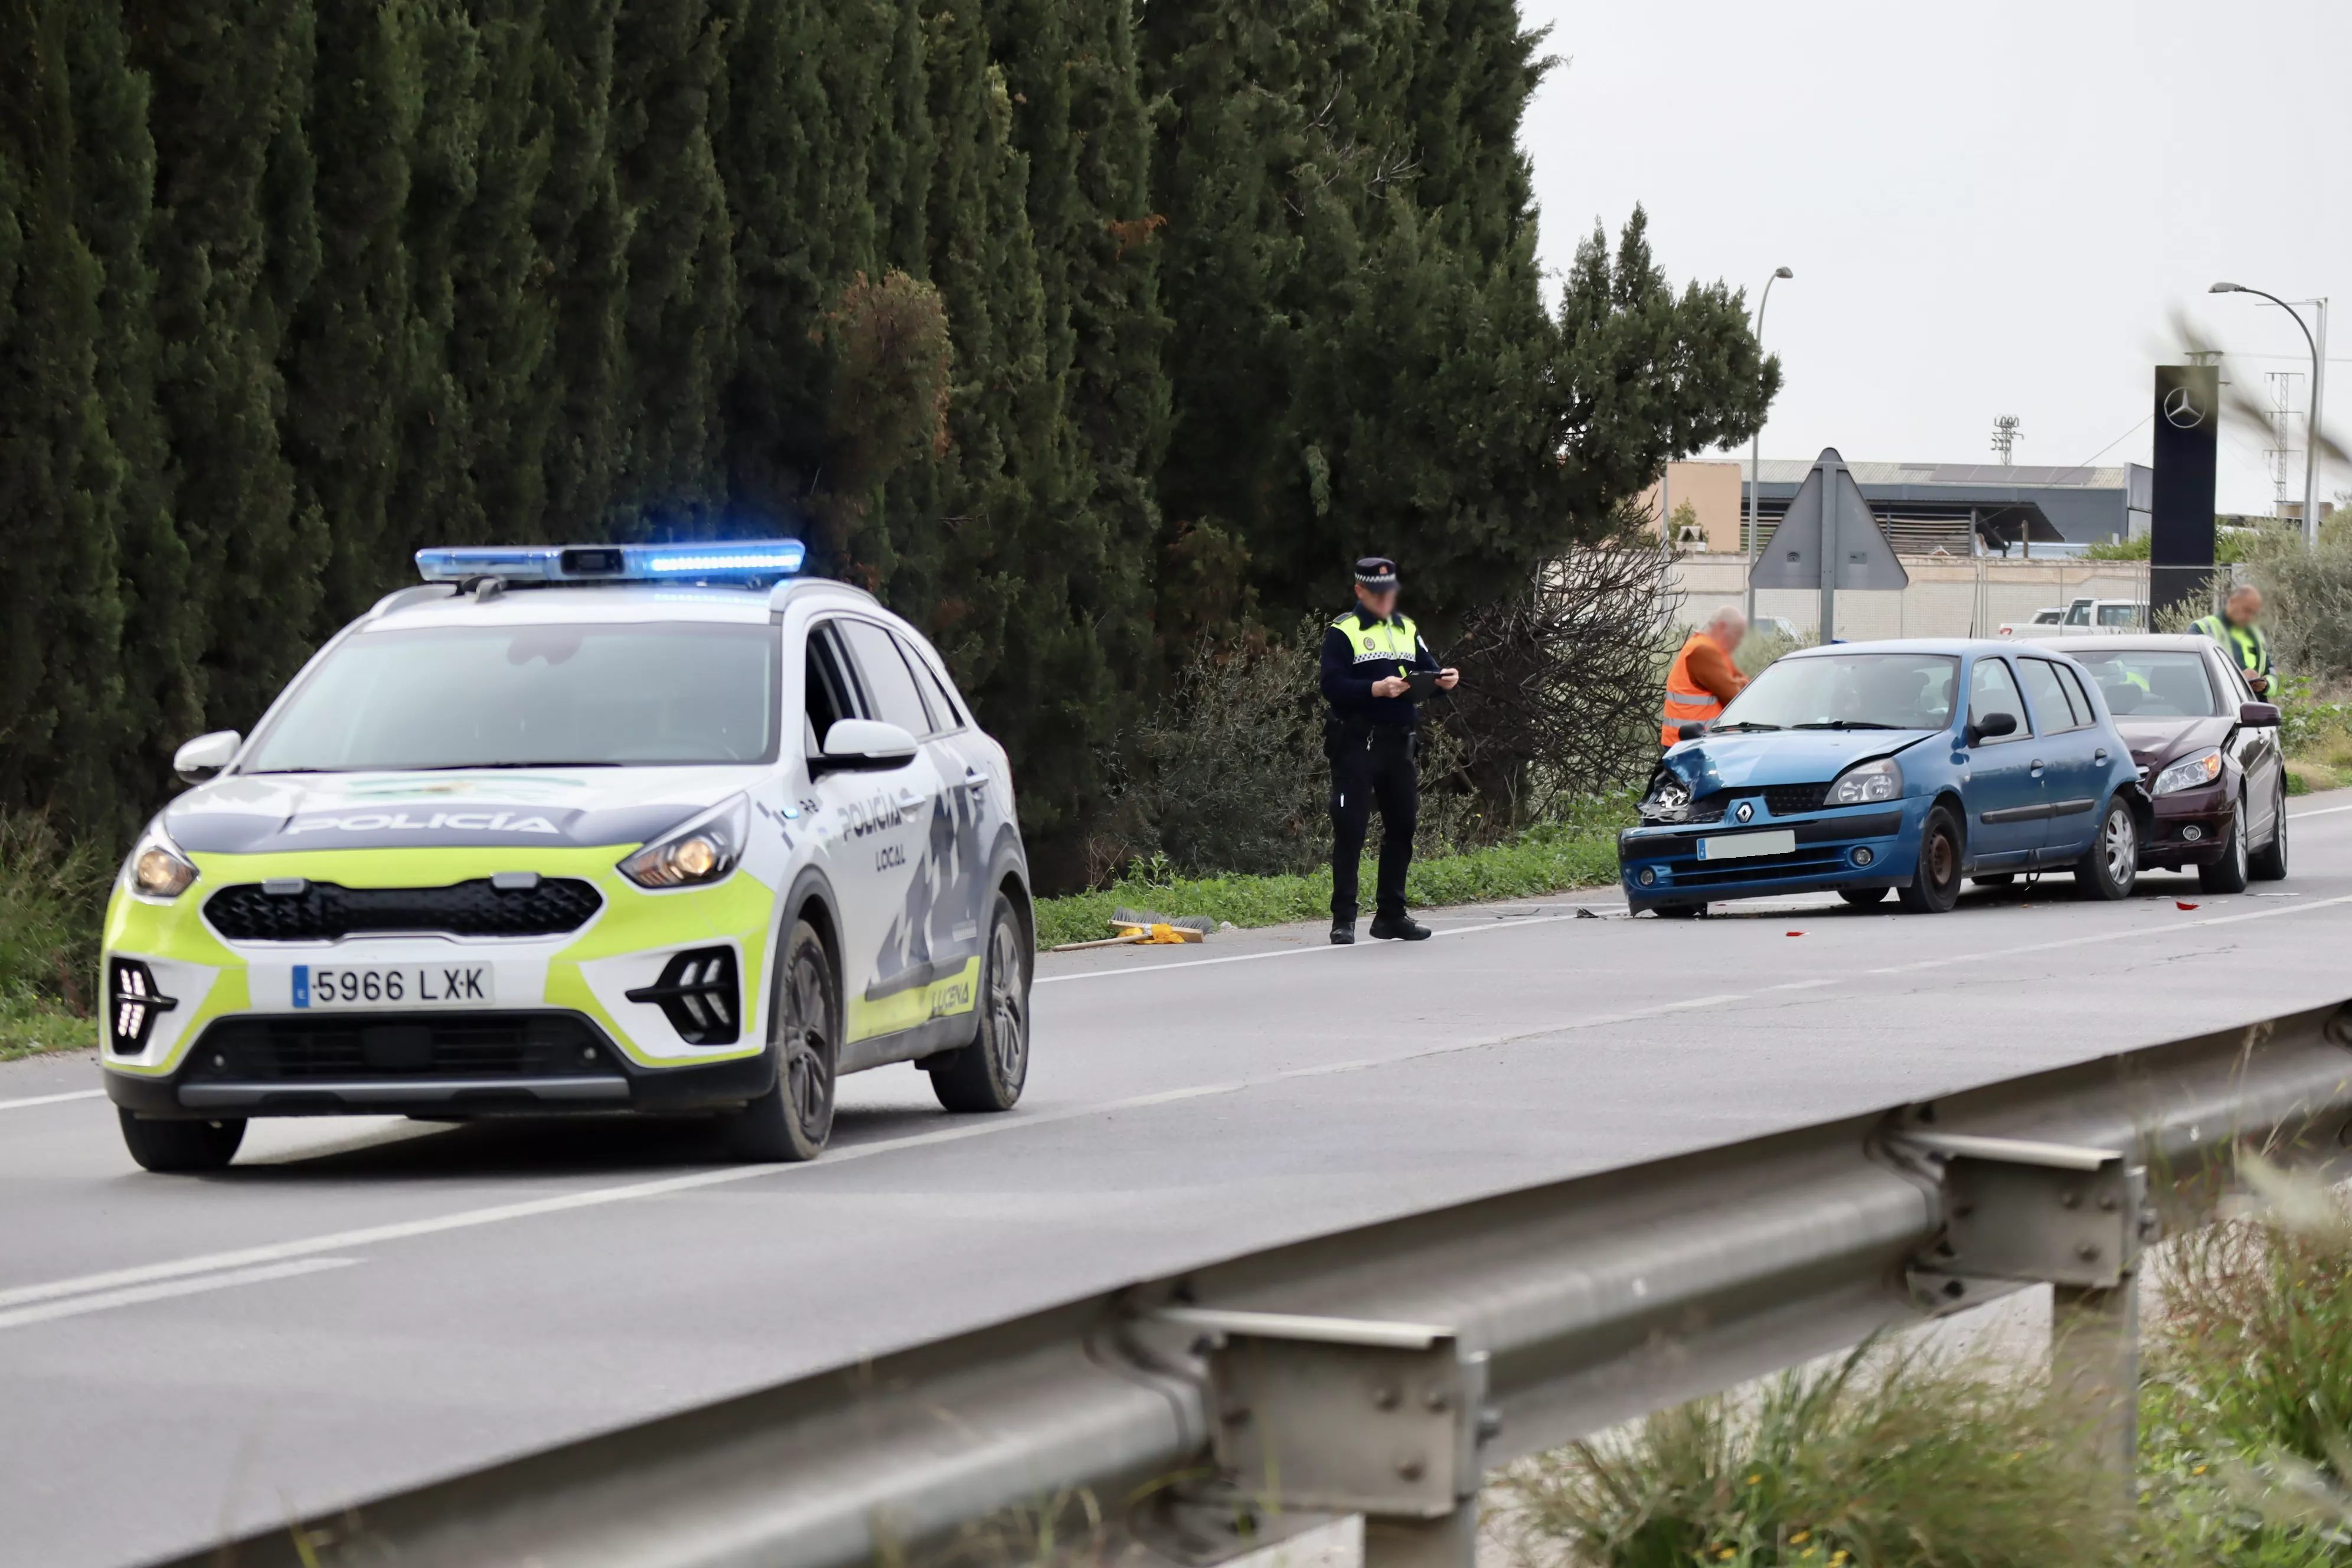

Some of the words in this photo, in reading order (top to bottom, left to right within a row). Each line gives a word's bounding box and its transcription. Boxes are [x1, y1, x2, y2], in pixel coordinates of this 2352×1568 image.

[288, 811, 560, 834] POLICÍA
[876, 844, 906, 872] LOCAL
[318, 971, 404, 1002] 5966
[420, 968, 485, 1001] LXK
[932, 981, 968, 1009] LUCENA
